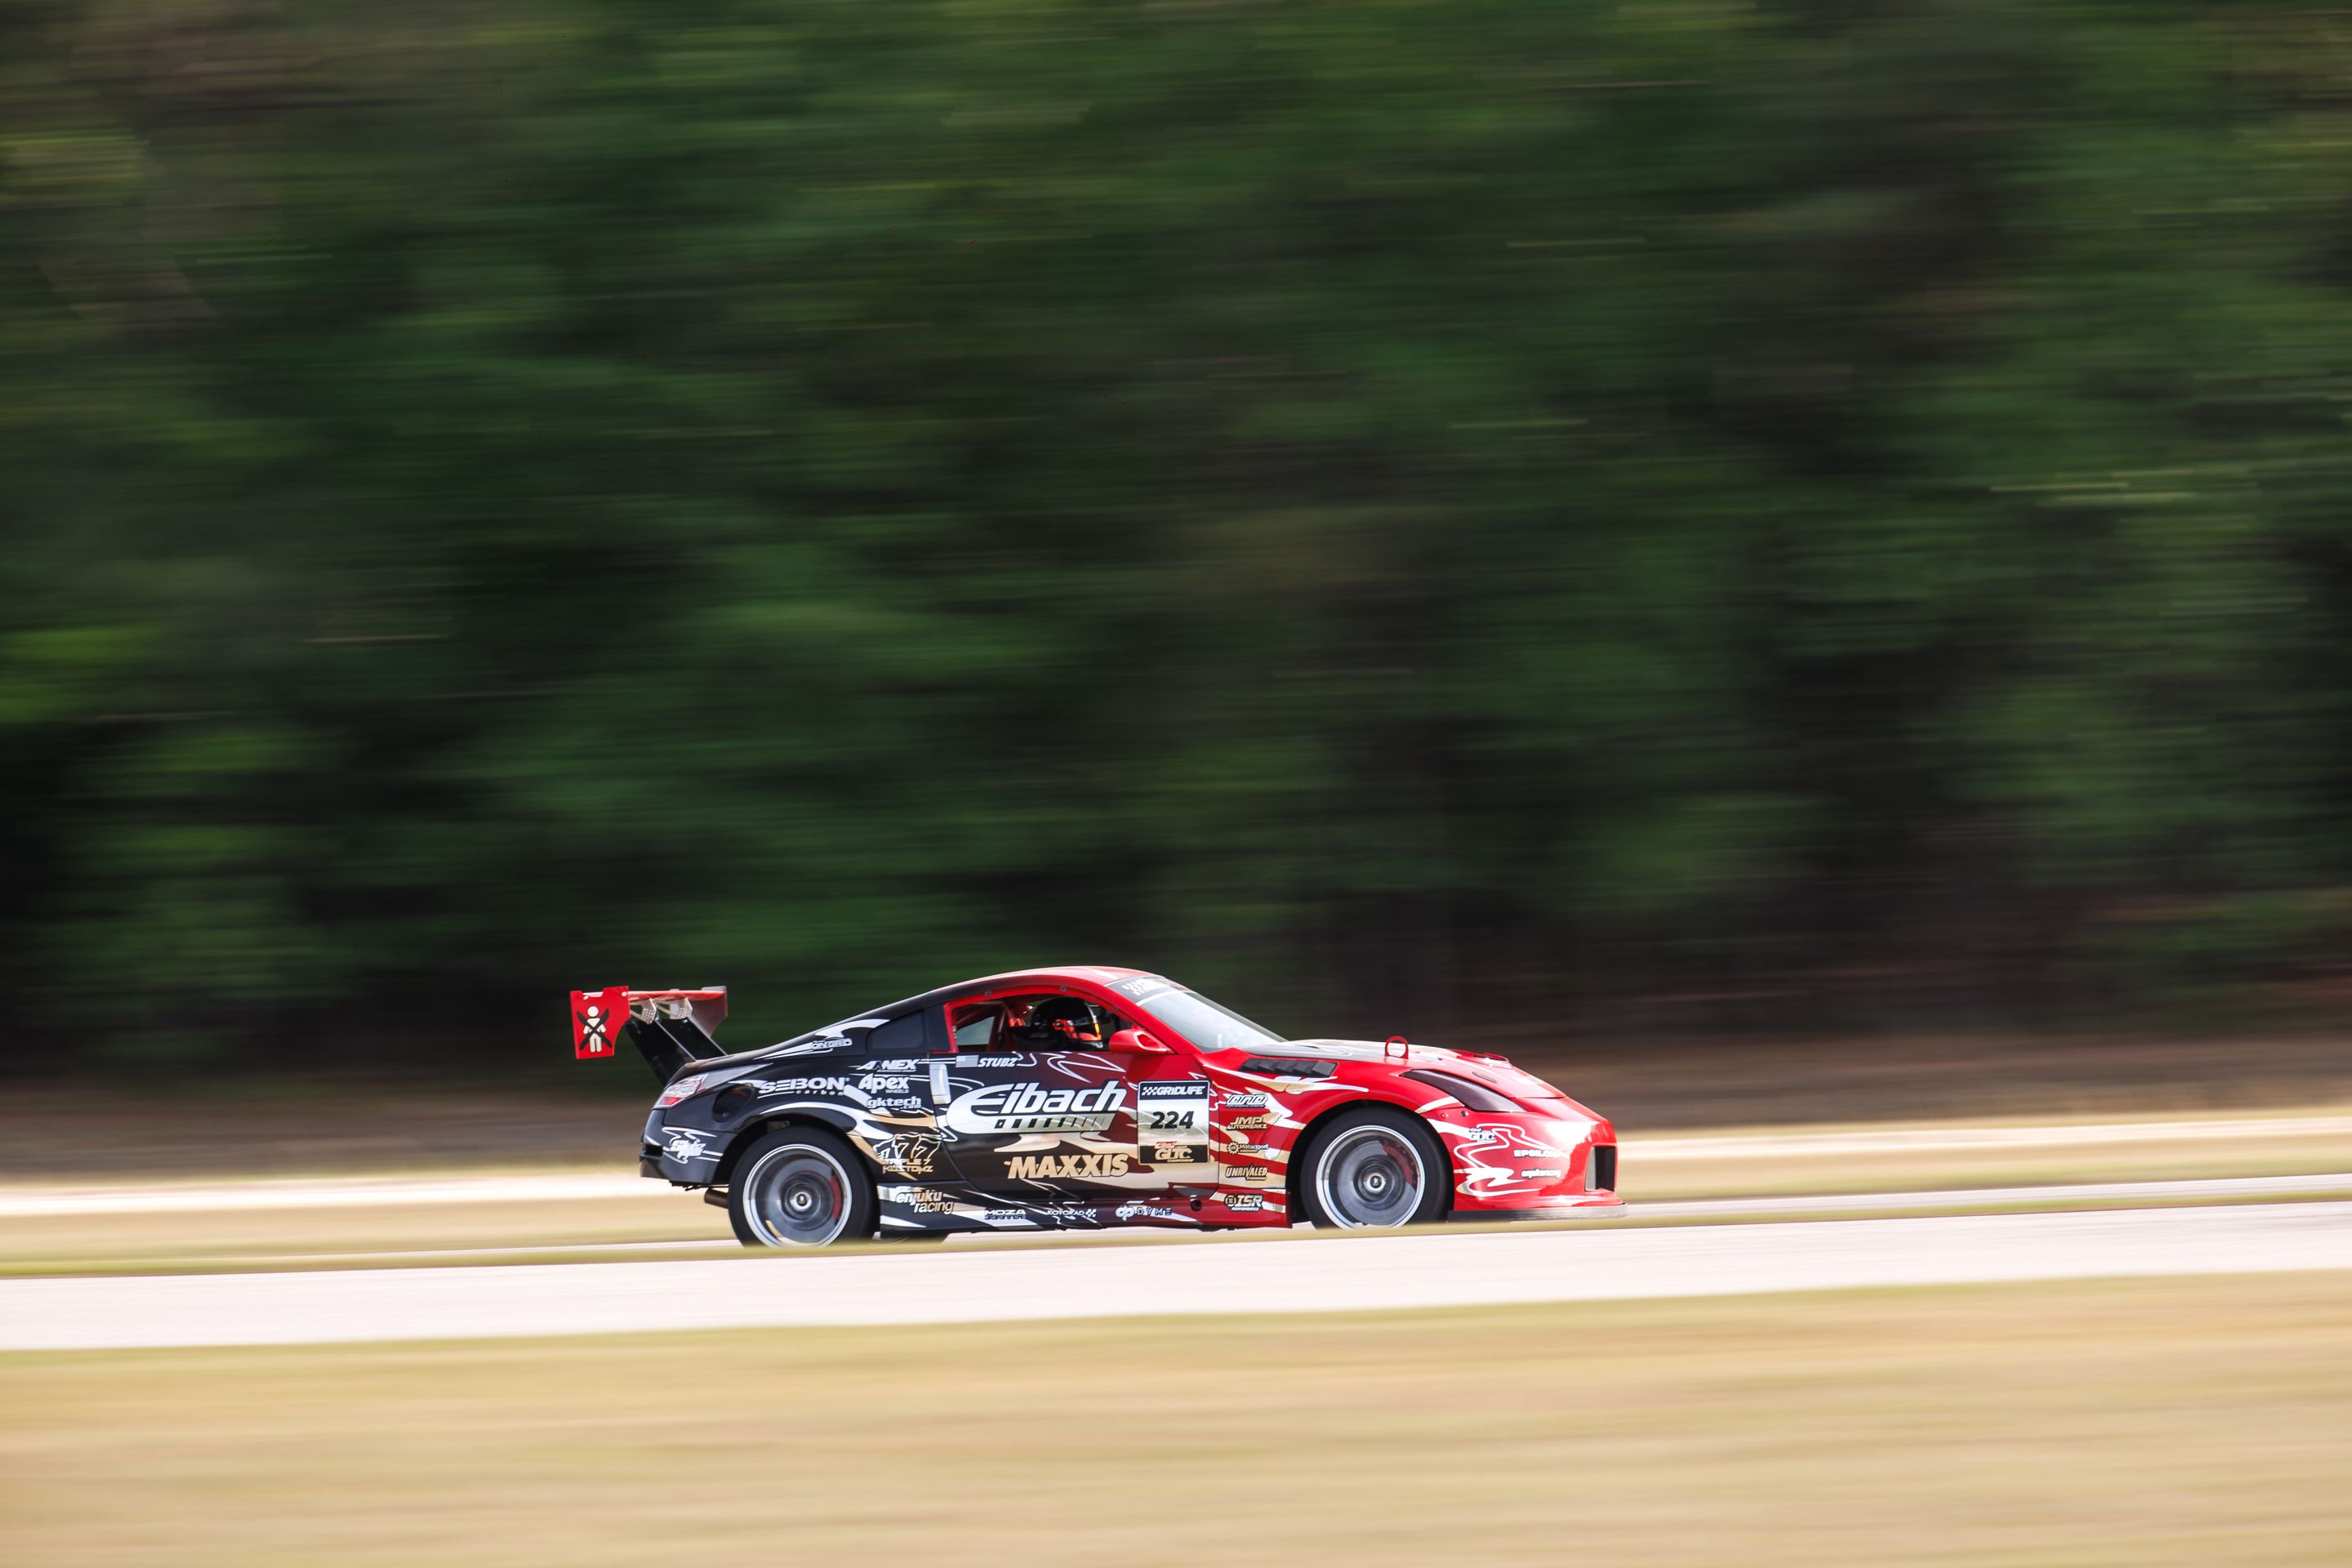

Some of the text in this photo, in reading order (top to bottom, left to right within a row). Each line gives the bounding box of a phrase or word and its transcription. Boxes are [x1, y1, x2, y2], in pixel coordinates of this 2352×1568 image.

[978, 1057, 1020, 1067] STUBZ
[858, 1073, 910, 1094] Apex
[1156, 1085, 1206, 1095] GRIDLIFE
[946, 1080, 1127, 1130] Eibach
[1149, 1111, 1194, 1129] 224
[1229, 1116, 1264, 1125] JMP
[1155, 1147, 1192, 1160] GLTC
[1007, 1154, 1129, 1179] MAXXIS
[1225, 1164, 1267, 1178] UNRIVALED
[913, 1201, 954, 1215] racing
[1136, 1206, 1172, 1216] DYME
